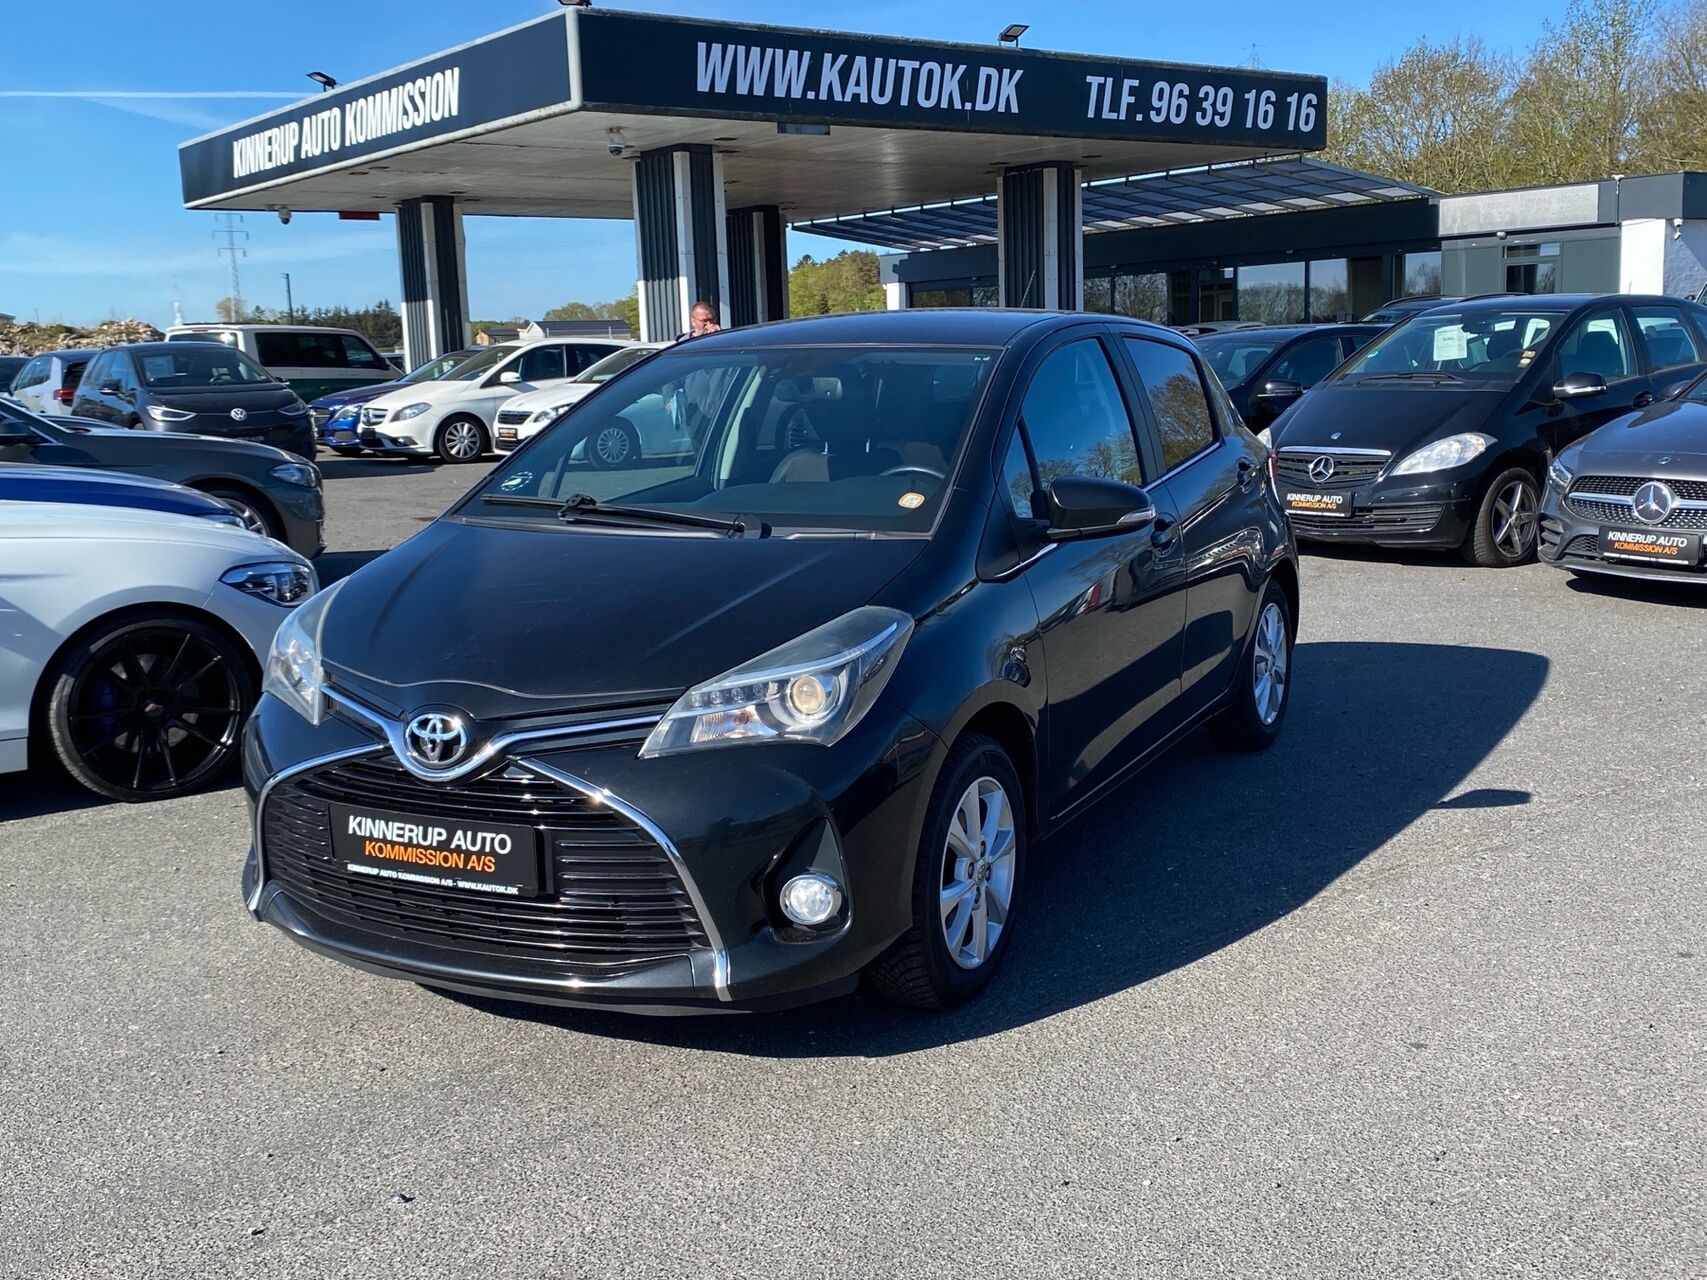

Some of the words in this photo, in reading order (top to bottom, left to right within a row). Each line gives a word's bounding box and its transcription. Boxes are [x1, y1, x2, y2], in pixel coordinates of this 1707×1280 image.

[697, 41, 1024, 114] WWW.KAUTOK.DK
[1086, 75, 1143, 121] TLF.
[1150, 81, 1190, 125] 96
[1195, 85, 1234, 127] 39
[1244, 89, 1276, 130] 16
[1286, 92, 1318, 133] 16
[232, 122, 299, 179] KINNERUP
[300, 107, 341, 160] AUTO
[344, 66, 460, 146] KOMMISSION
[1287, 493, 1321, 502] KINNERUP
[1322, 495, 1343, 504] AUTO
[1608, 531, 1656, 544] KINNERUP
[1658, 536, 1687, 547] AUTO
[1614, 541, 1663, 554] KOMMISSION
[1663, 546, 1678, 555] A/S
[348, 815, 447, 847] KINNERUP
[450, 829, 512, 855] AUTO
[365, 841, 464, 869] KOMMISSION
[467, 855, 495, 873] A/S
[379, 869, 397, 878] AUTO
